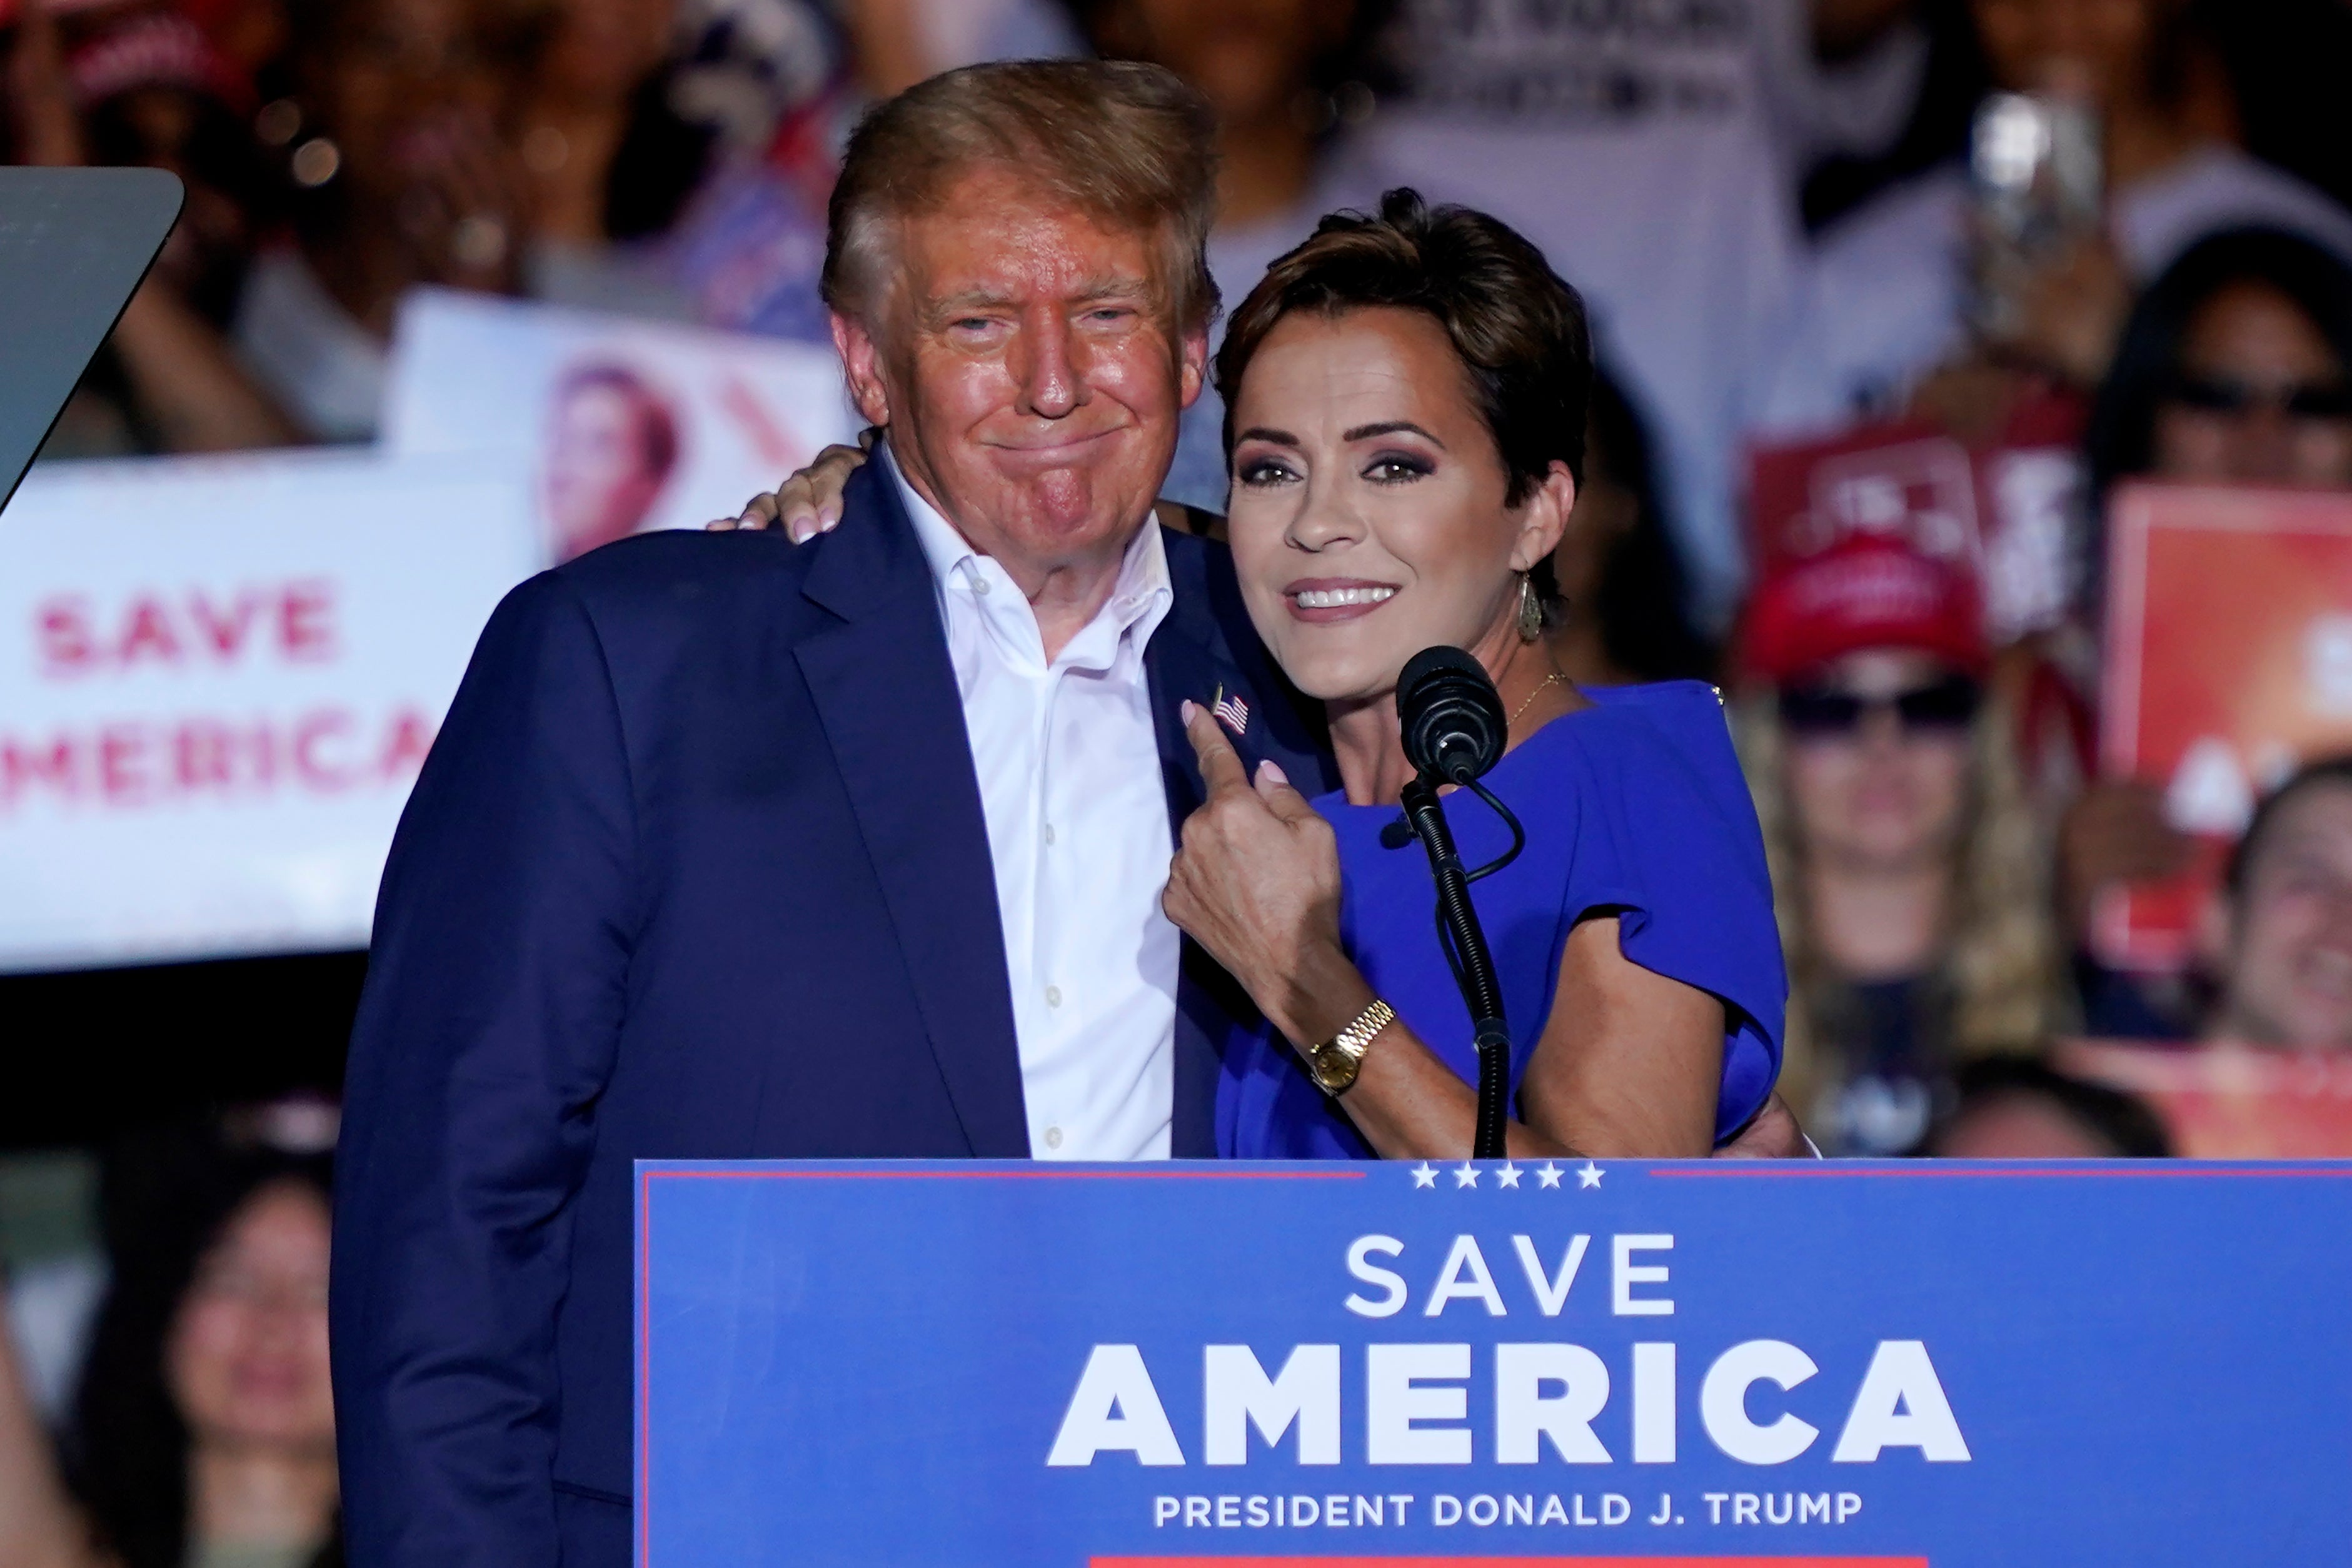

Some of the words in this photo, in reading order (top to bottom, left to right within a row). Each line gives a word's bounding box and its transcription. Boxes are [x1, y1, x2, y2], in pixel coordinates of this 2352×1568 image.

[34, 581, 339, 676] SAVE
[0, 705, 438, 813] MERICA
[1344, 1234, 1675, 1317] SAVE
[1045, 1339, 1973, 1466] AMERICA
[1155, 1495, 1415, 1528] PRESIDENT
[1433, 1493, 1631, 1527] DONALD
[1649, 1492, 1685, 1526] J.
[1704, 1492, 1862, 1525] TRUMP
